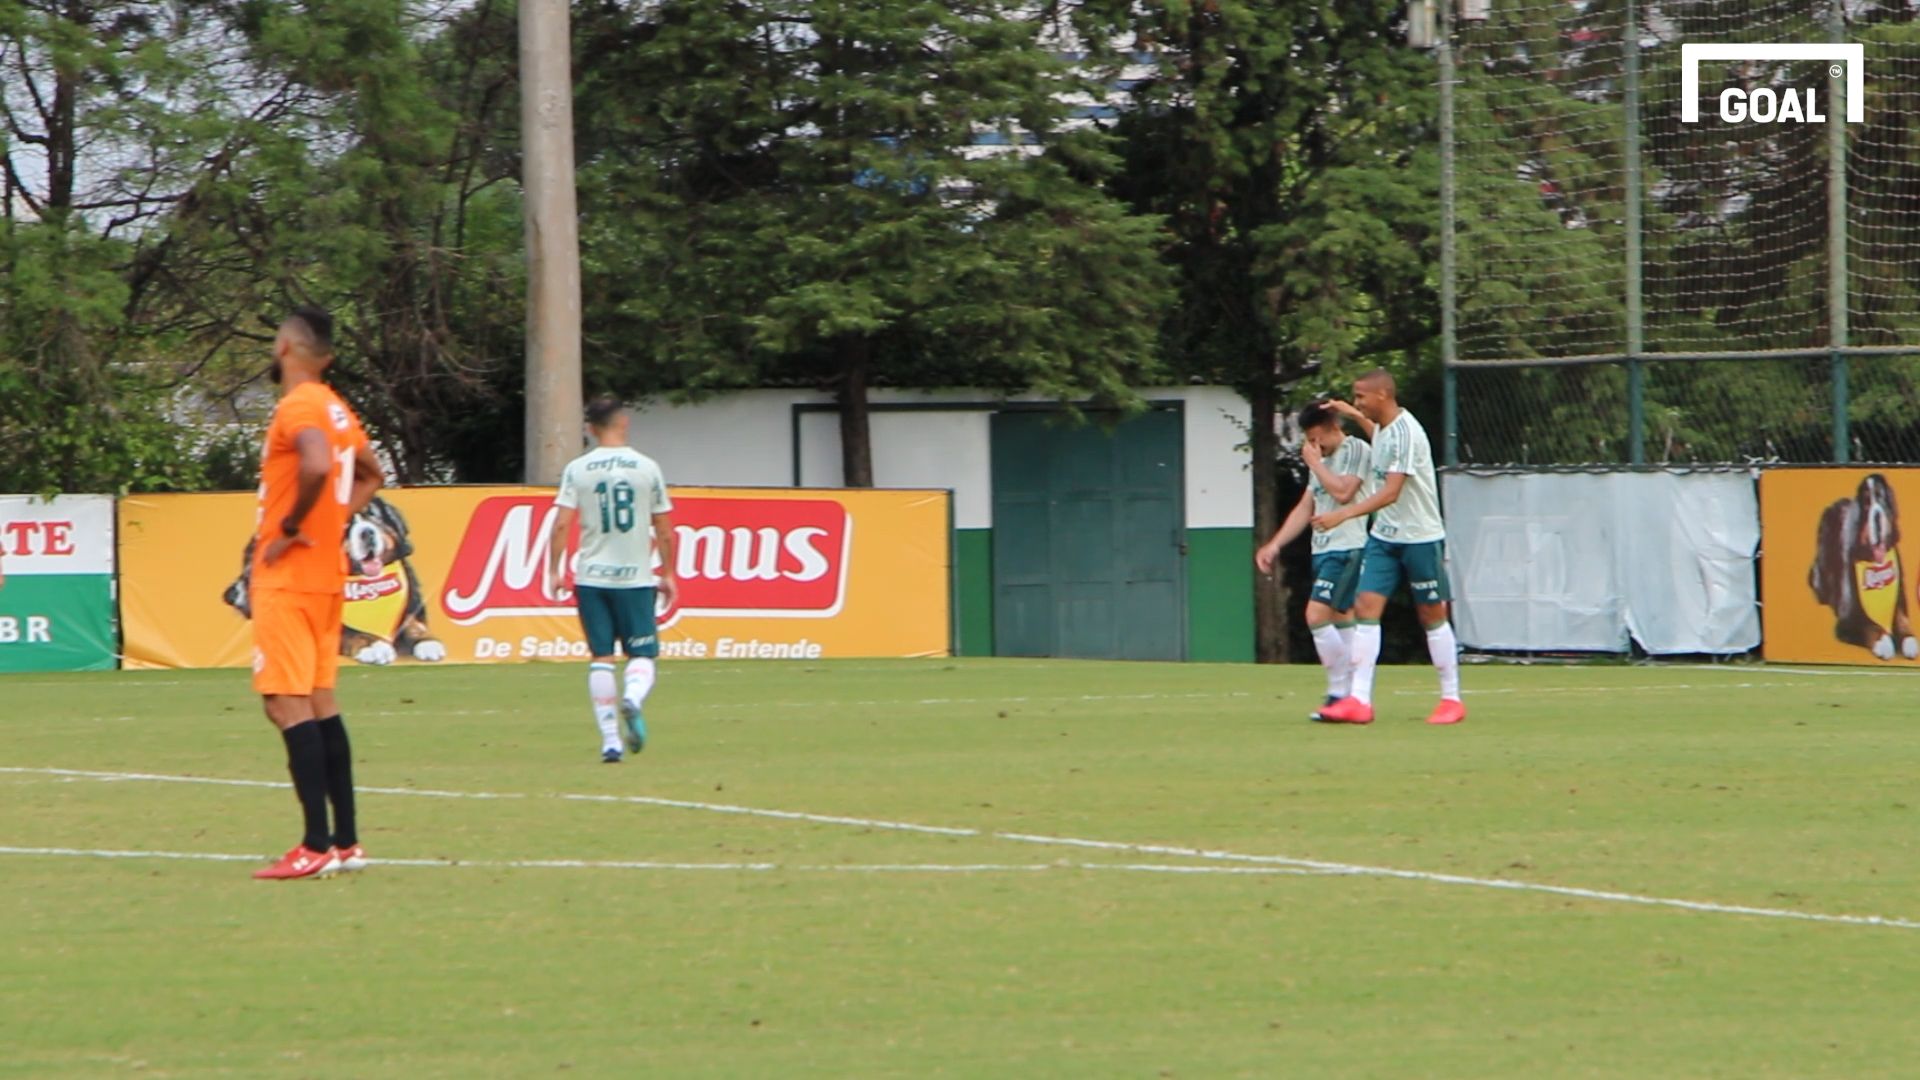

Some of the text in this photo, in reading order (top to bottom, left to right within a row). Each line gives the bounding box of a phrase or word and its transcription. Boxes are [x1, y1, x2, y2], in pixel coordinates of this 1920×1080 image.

[594, 481, 634, 534] 18
[445, 504, 829, 615] Mnus
[474, 637, 512, 658] De
[519, 636, 592, 657] Sabo
[715, 637, 821, 658] Entende
